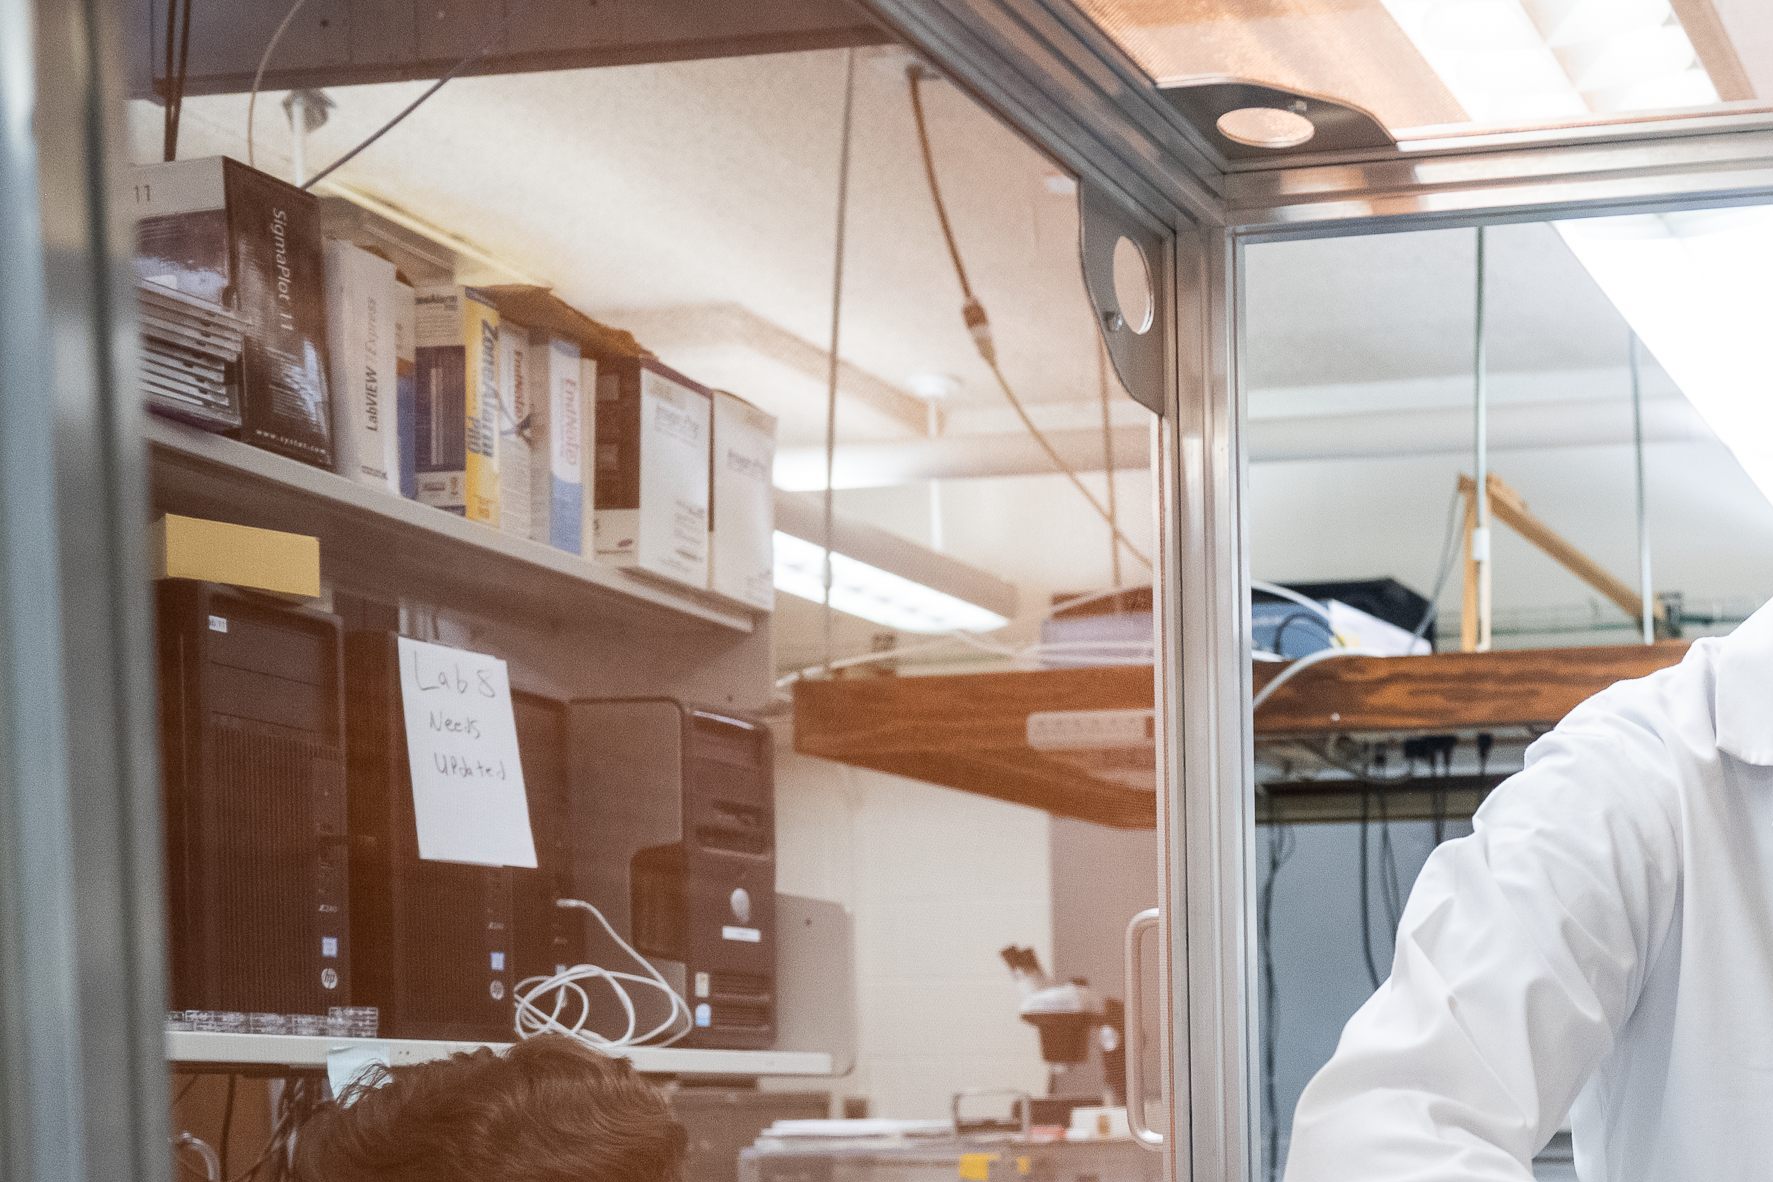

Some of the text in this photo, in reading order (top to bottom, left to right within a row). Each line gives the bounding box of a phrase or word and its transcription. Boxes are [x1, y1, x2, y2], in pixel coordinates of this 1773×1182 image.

[270, 207, 294, 331] SigmaPlot 11
[365, 366, 378, 432] LabVIEW
[480, 318, 499, 458] ZoneAlarm
[413, 650, 469, 694] Lab
[429, 710, 481, 740] Needs
